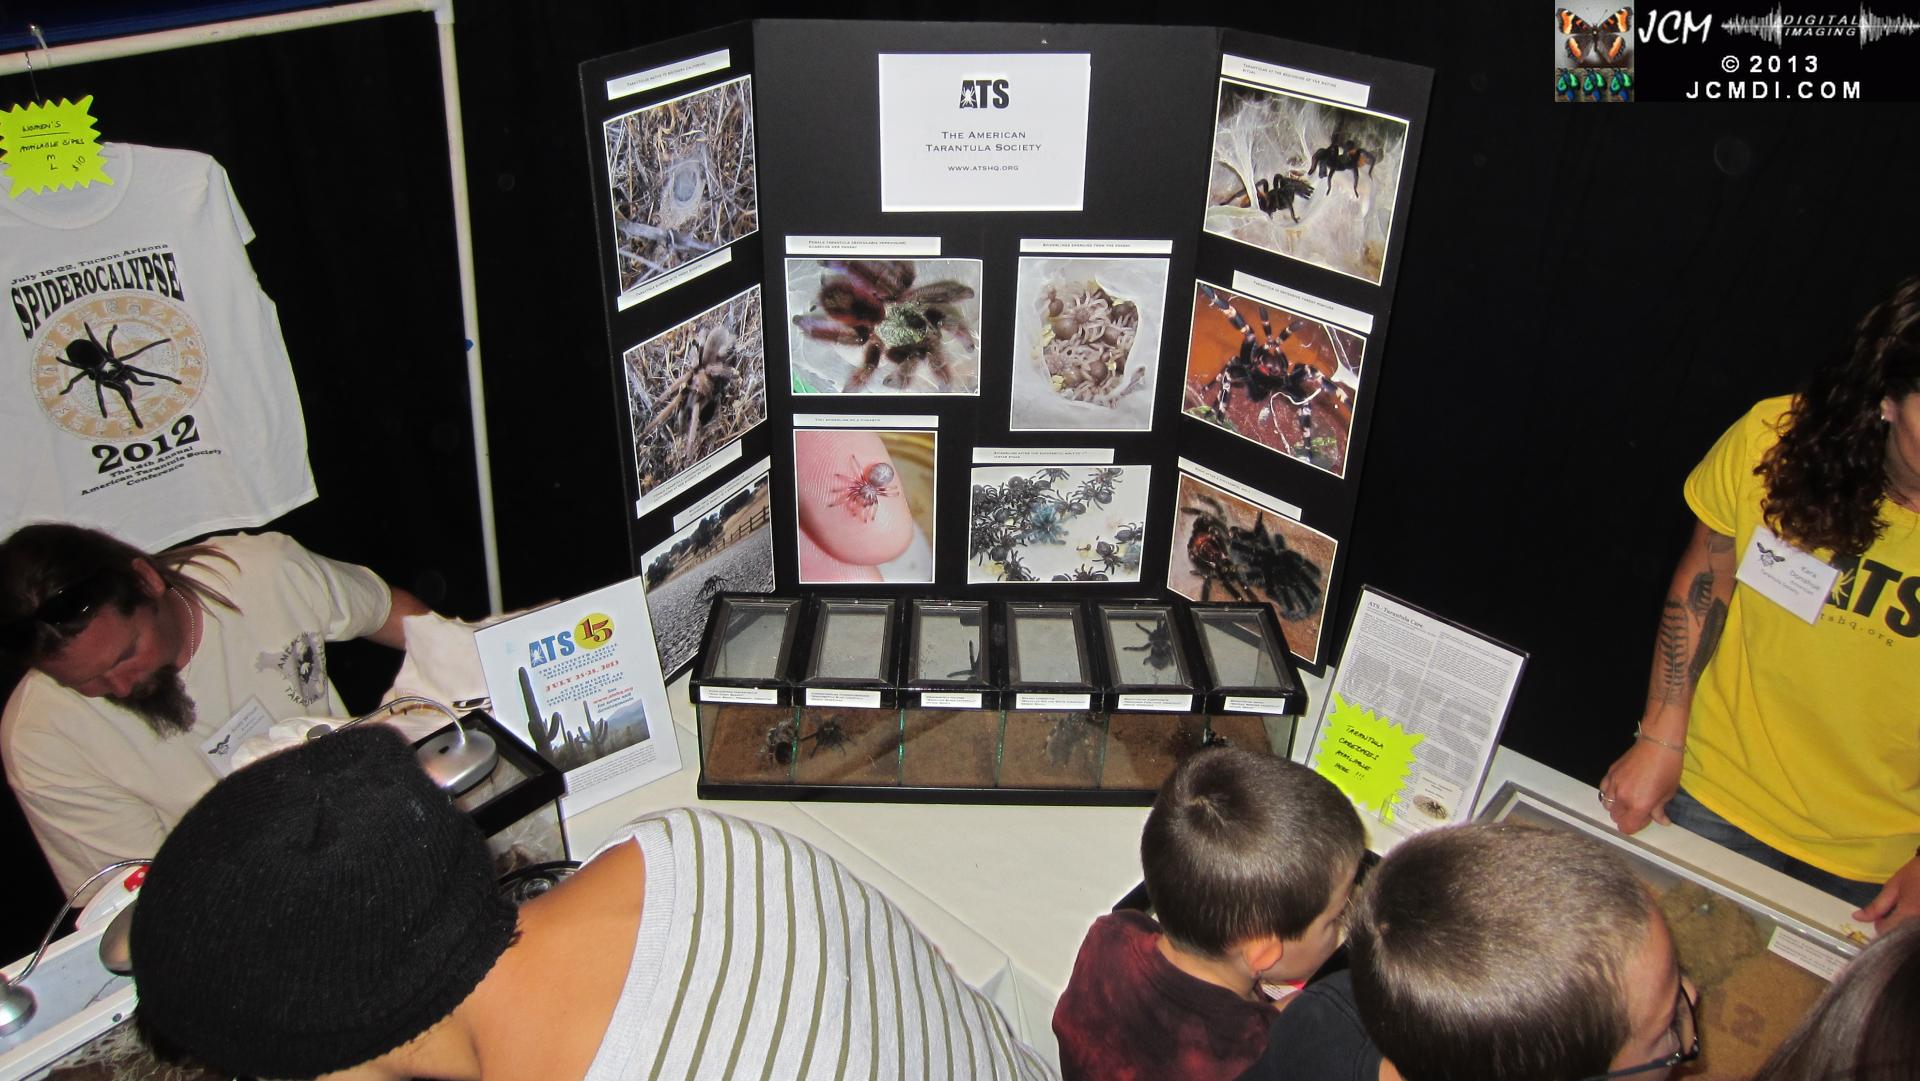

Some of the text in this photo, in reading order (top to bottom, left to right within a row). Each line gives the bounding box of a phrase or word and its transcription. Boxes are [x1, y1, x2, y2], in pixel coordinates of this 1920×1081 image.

[959, 79, 1010, 109] ATS
[926, 143, 1042, 152] TARANTULA SOCIETY
[968, 131, 1026, 139] AMERICAN
[50, 163, 59, 171] L
[11, 273, 37, 285] July
[78, 253, 121, 267] Tucson
[122, 243, 169, 257] Arizona
[11, 252, 185, 342] SPIDEROCALYPSE
[91, 415, 200, 474] 2012
[157, 446, 194, 463] Annual
[81, 449, 222, 496] American Tarantula Society
[126, 463, 185, 486] Conference
[528, 618, 614, 668] ATS 15
[1820, 613, 1894, 647] tshq.org
[546, 678, 571, 692] JULY
